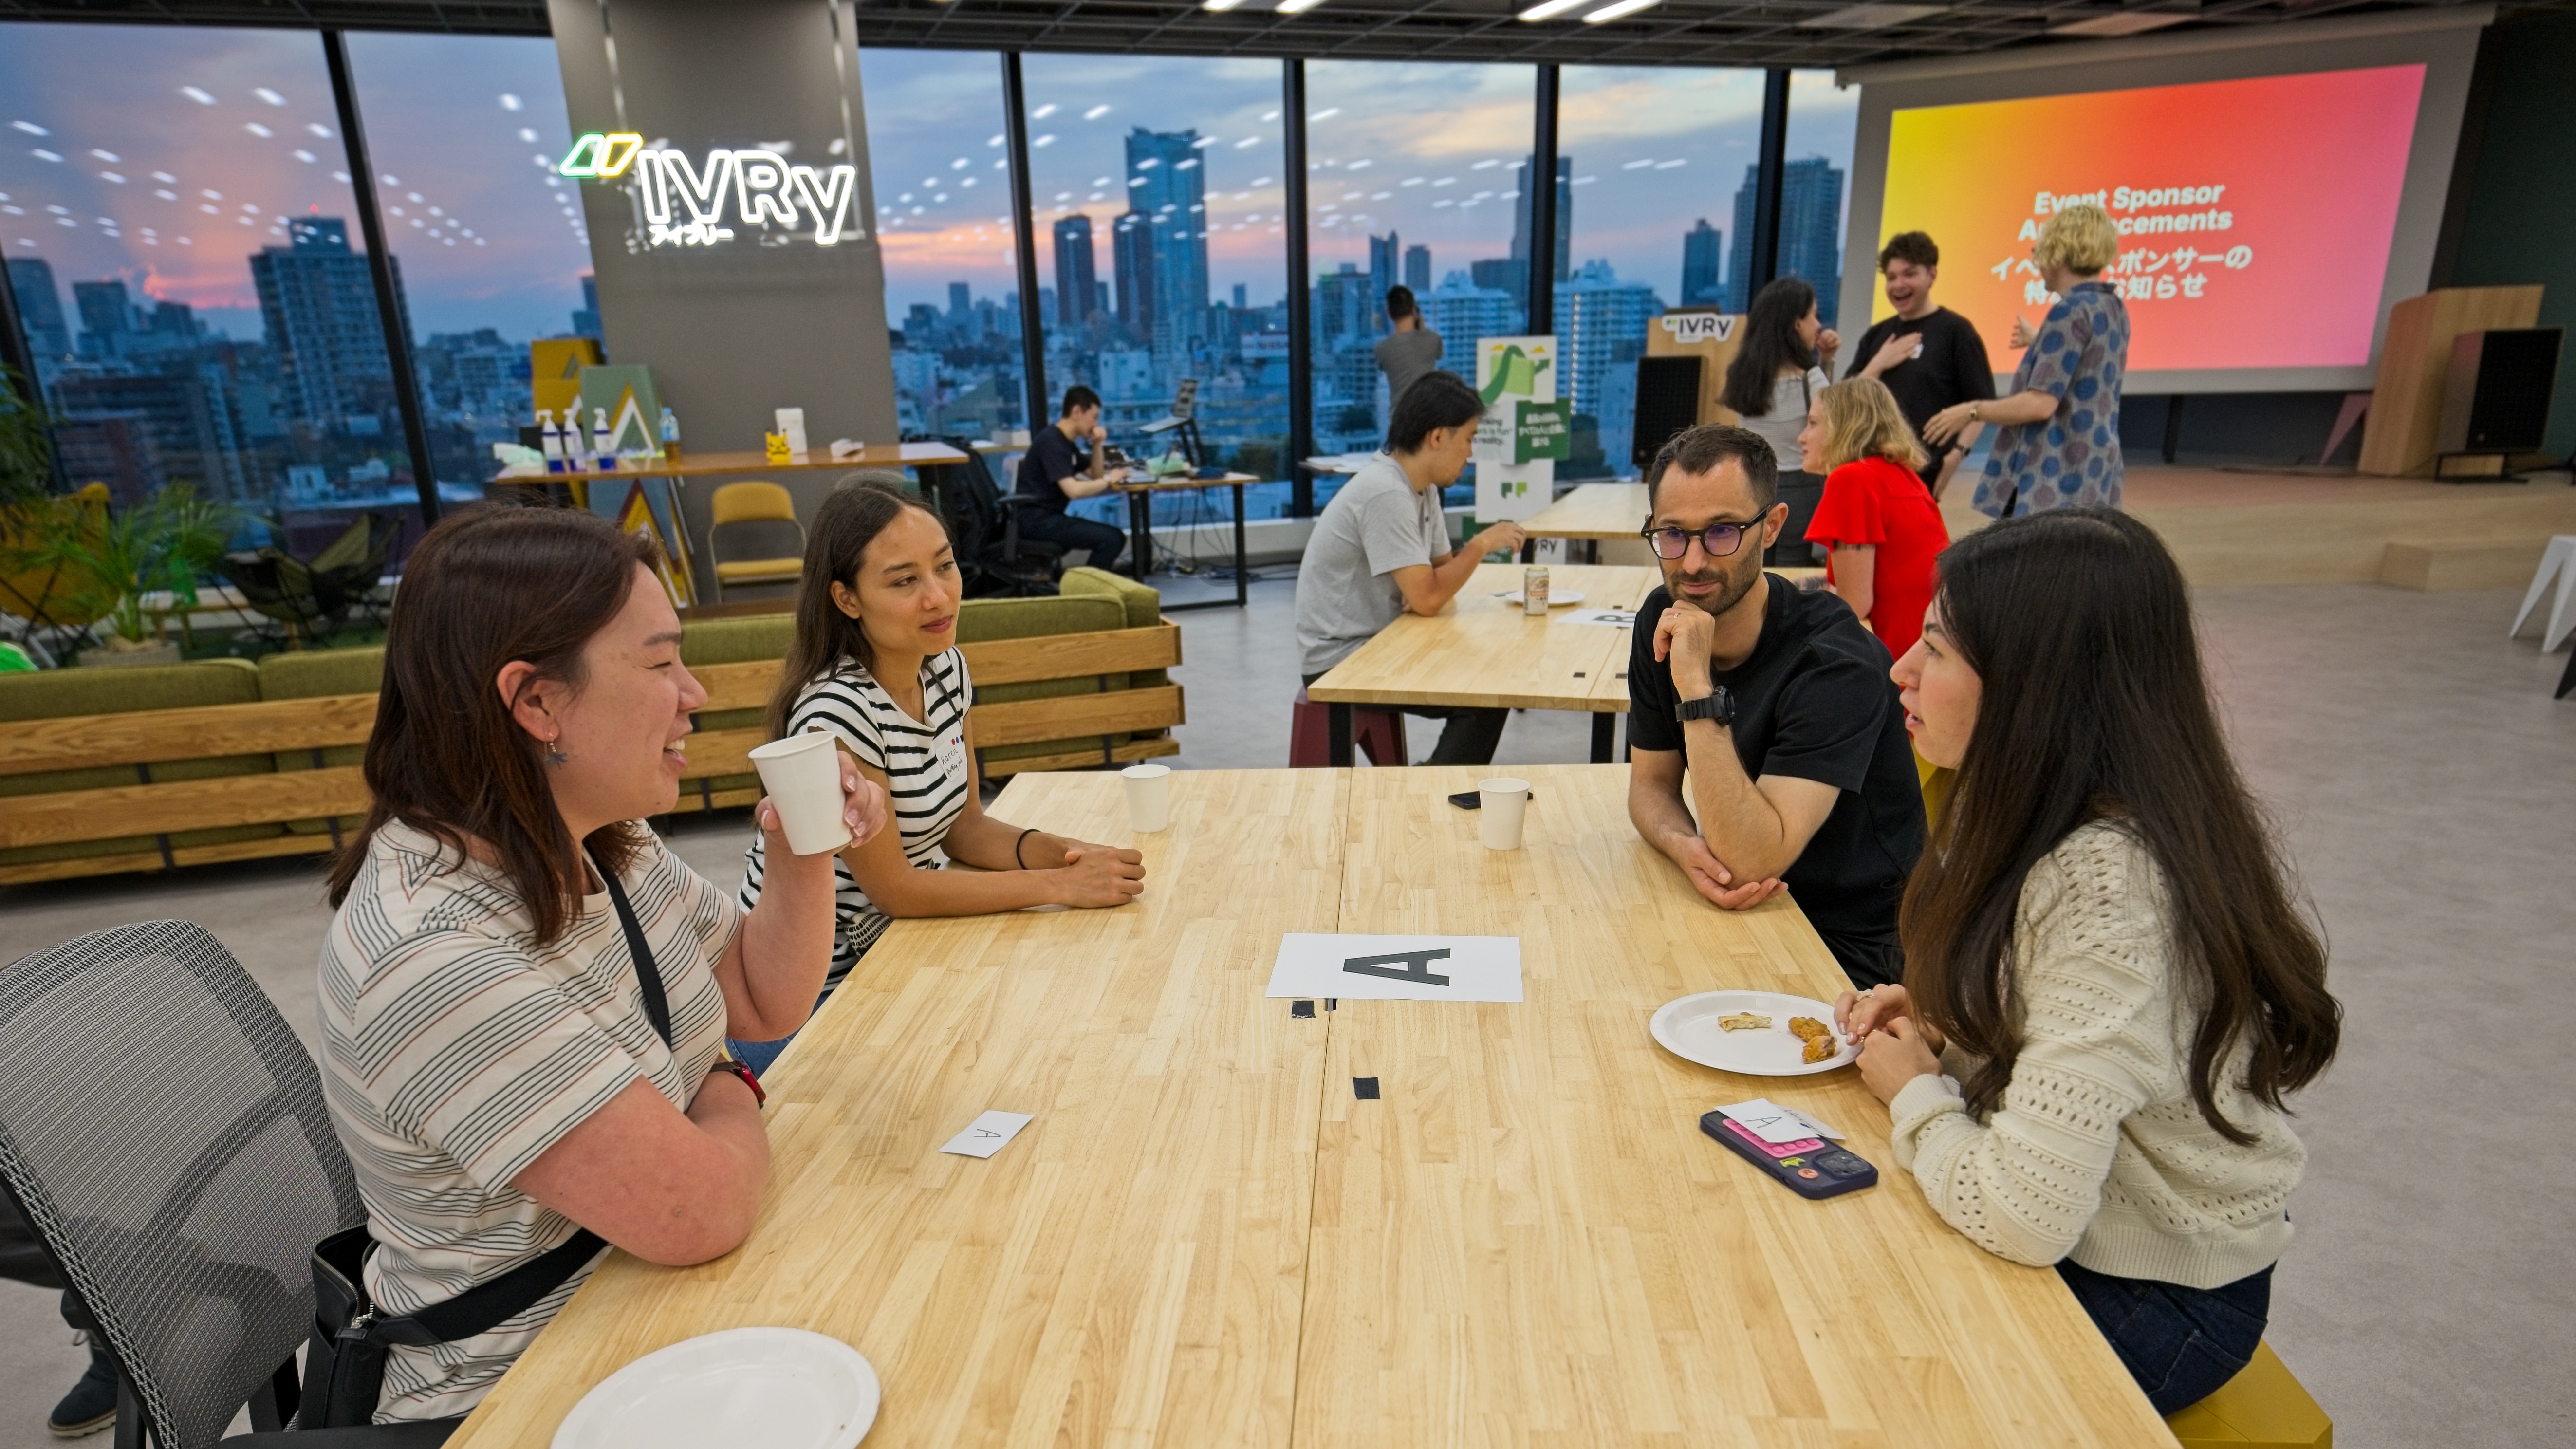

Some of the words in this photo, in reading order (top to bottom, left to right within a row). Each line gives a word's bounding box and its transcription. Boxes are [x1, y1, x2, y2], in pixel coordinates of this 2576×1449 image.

[2113, 185, 2224, 213] Sponsor
[2018, 209, 2233, 241] Acements
[940, 748, 958, 765] Karen
[1343, 948, 1451, 987] A
[973, 1128, 1001, 1138] A
[1744, 1116, 1782, 1129] A
